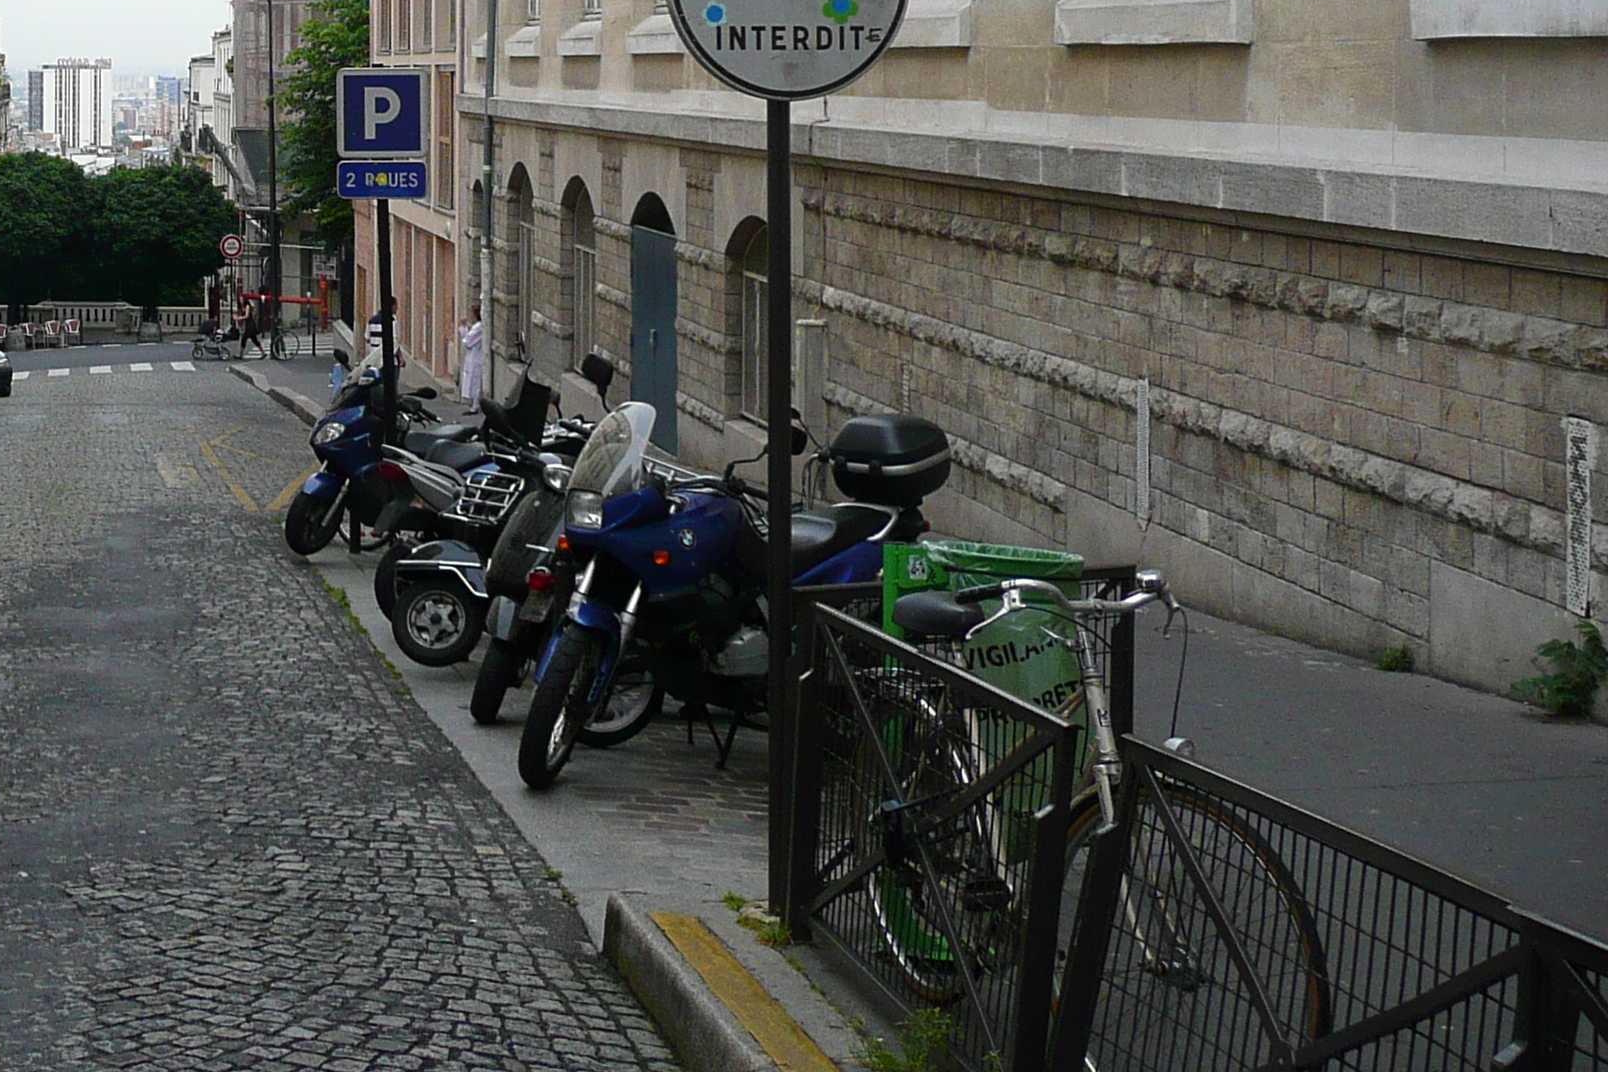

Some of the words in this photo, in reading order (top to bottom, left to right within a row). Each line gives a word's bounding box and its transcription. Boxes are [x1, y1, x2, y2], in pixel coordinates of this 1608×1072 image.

[364, 86, 402, 140] P
[345, 172, 356, 188] 2
[365, 172, 419, 188] RUES
